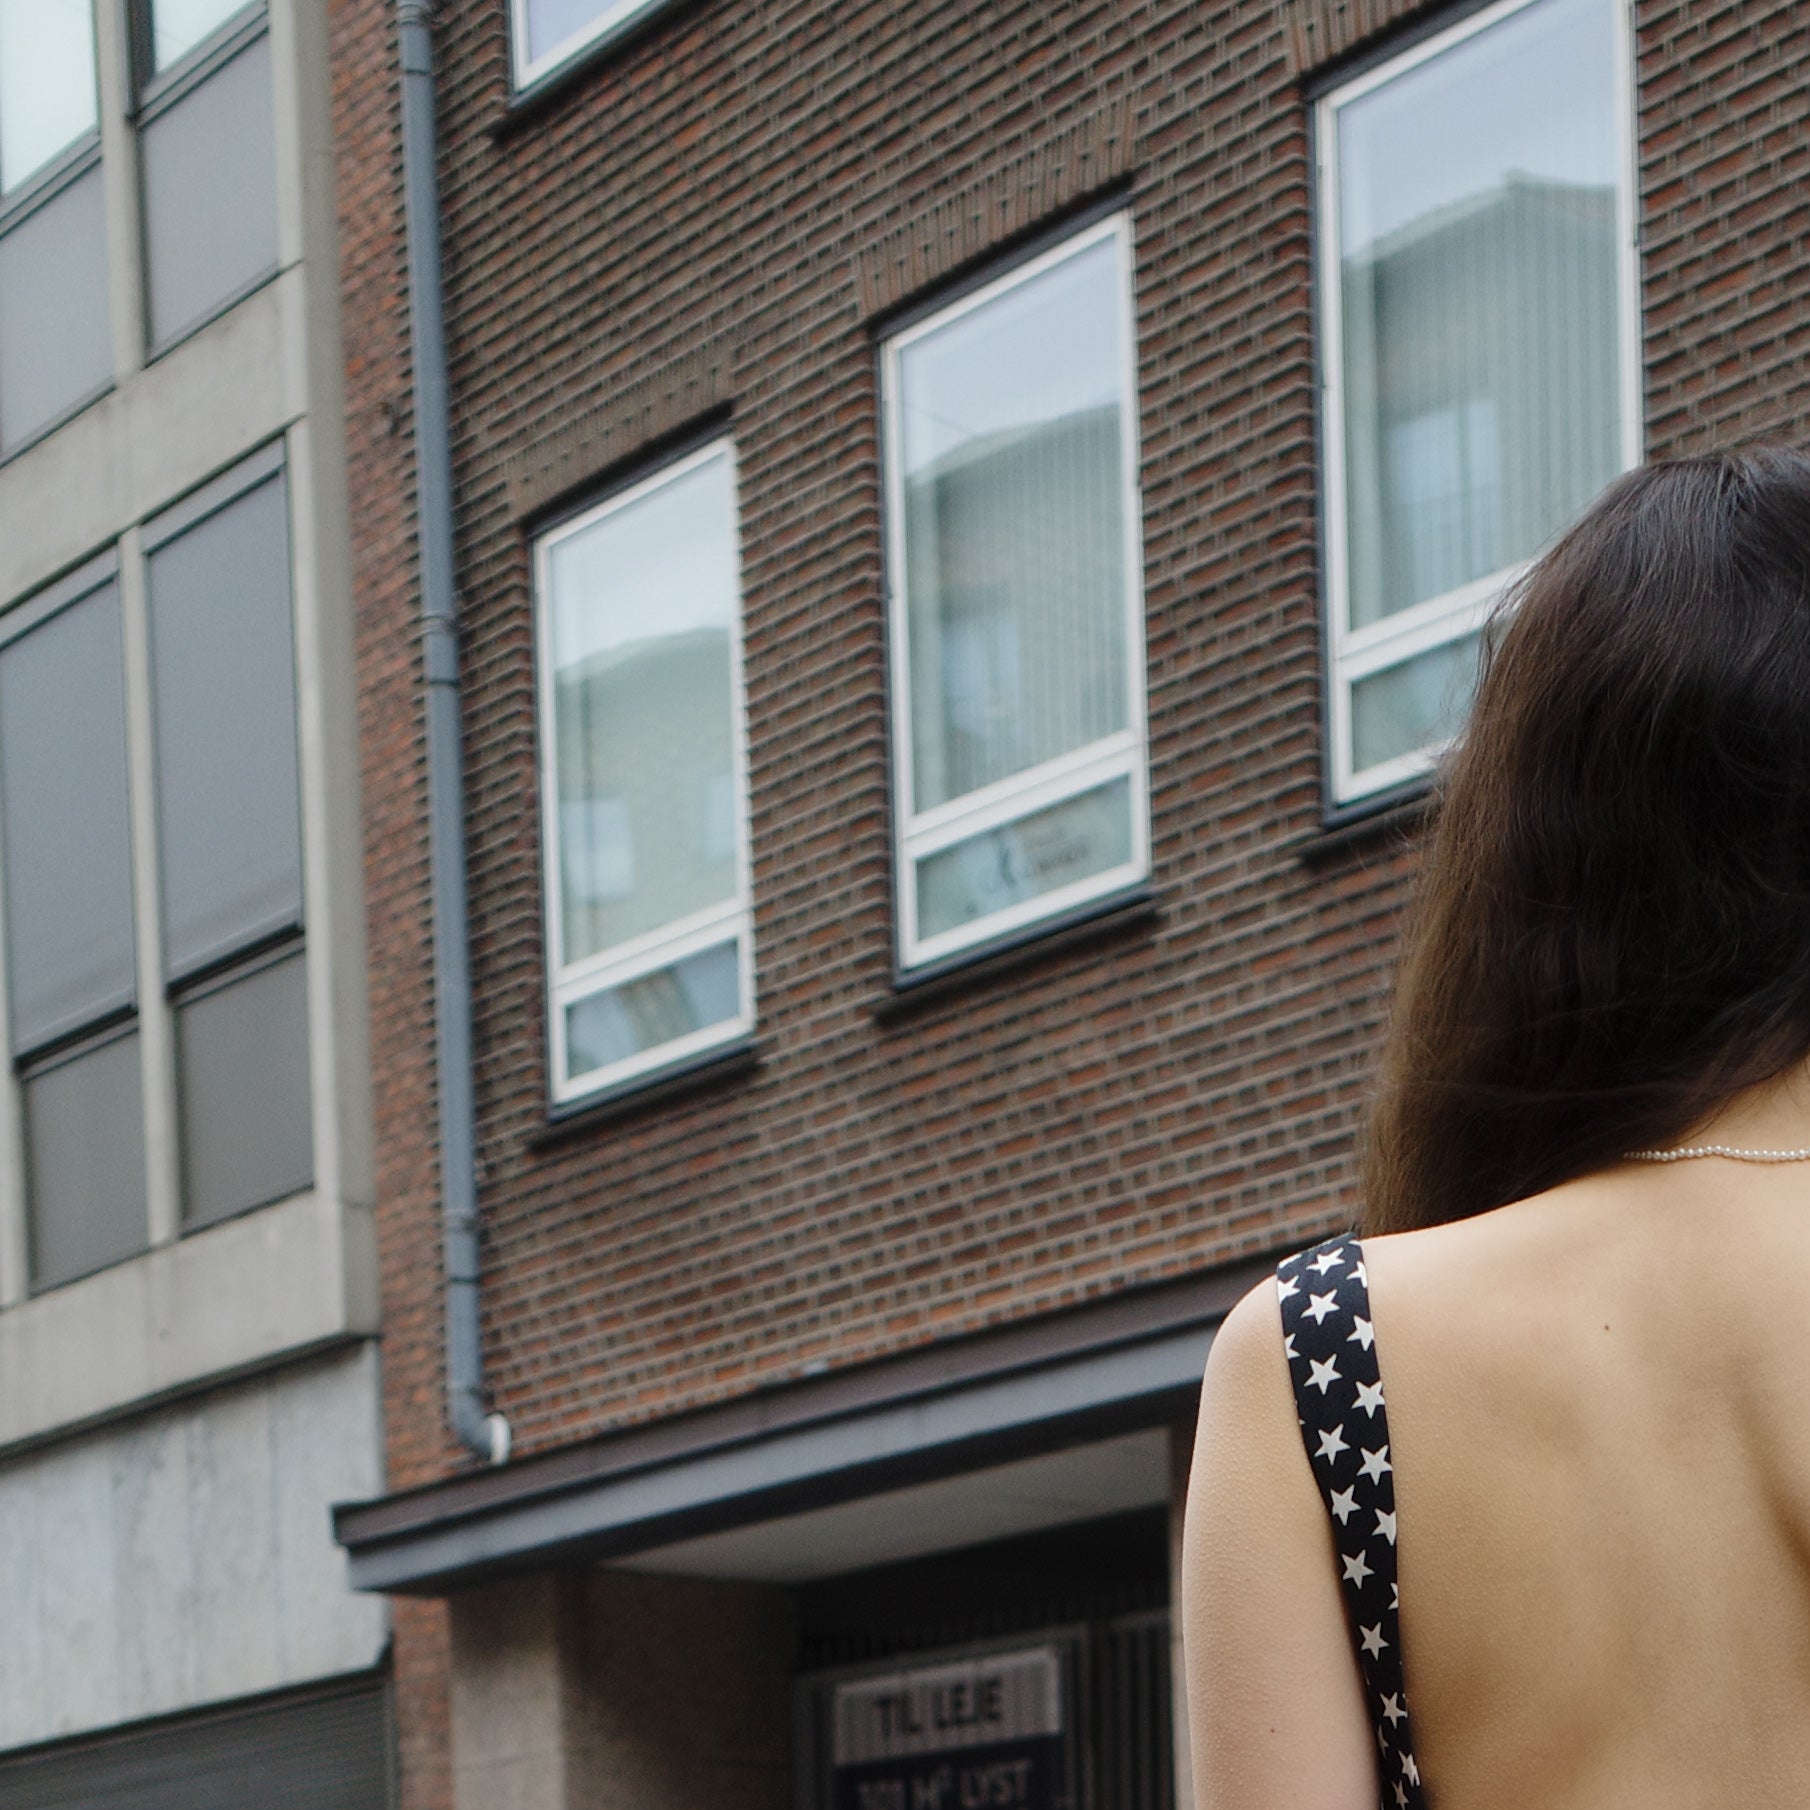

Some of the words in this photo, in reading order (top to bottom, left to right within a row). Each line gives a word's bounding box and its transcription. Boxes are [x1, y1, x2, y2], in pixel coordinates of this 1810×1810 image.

[874, 1692, 922, 1739] TIL
[935, 1678, 1004, 1730] LEJE
[960, 1759, 1033, 1808] LYST
